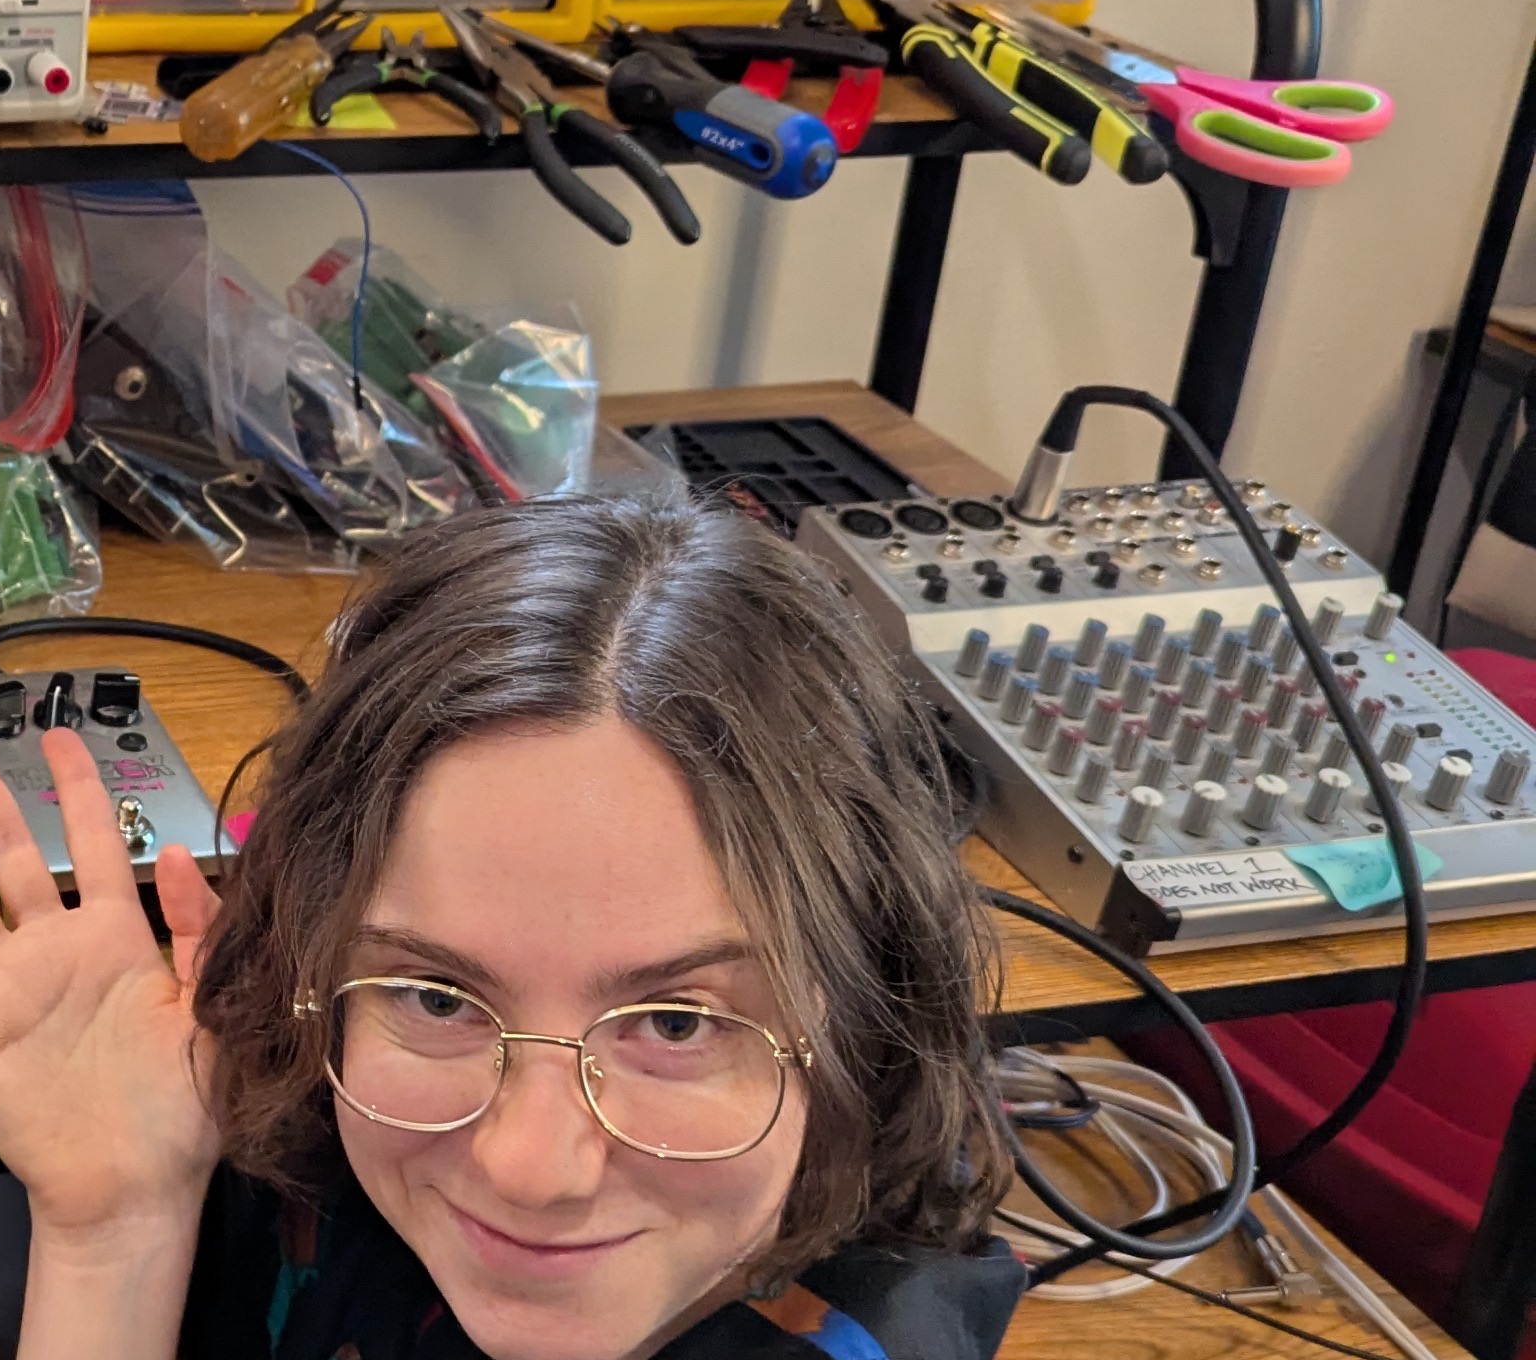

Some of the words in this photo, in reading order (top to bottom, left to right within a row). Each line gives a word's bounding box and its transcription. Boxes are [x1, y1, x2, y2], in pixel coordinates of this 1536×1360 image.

[1128, 861, 1237, 883] CHANNEL
[1242, 855, 1283, 876] 1
[1145, 883, 1198, 901] DOES
[1200, 880, 1236, 897] NOT
[1241, 875, 1307, 893] WORK
